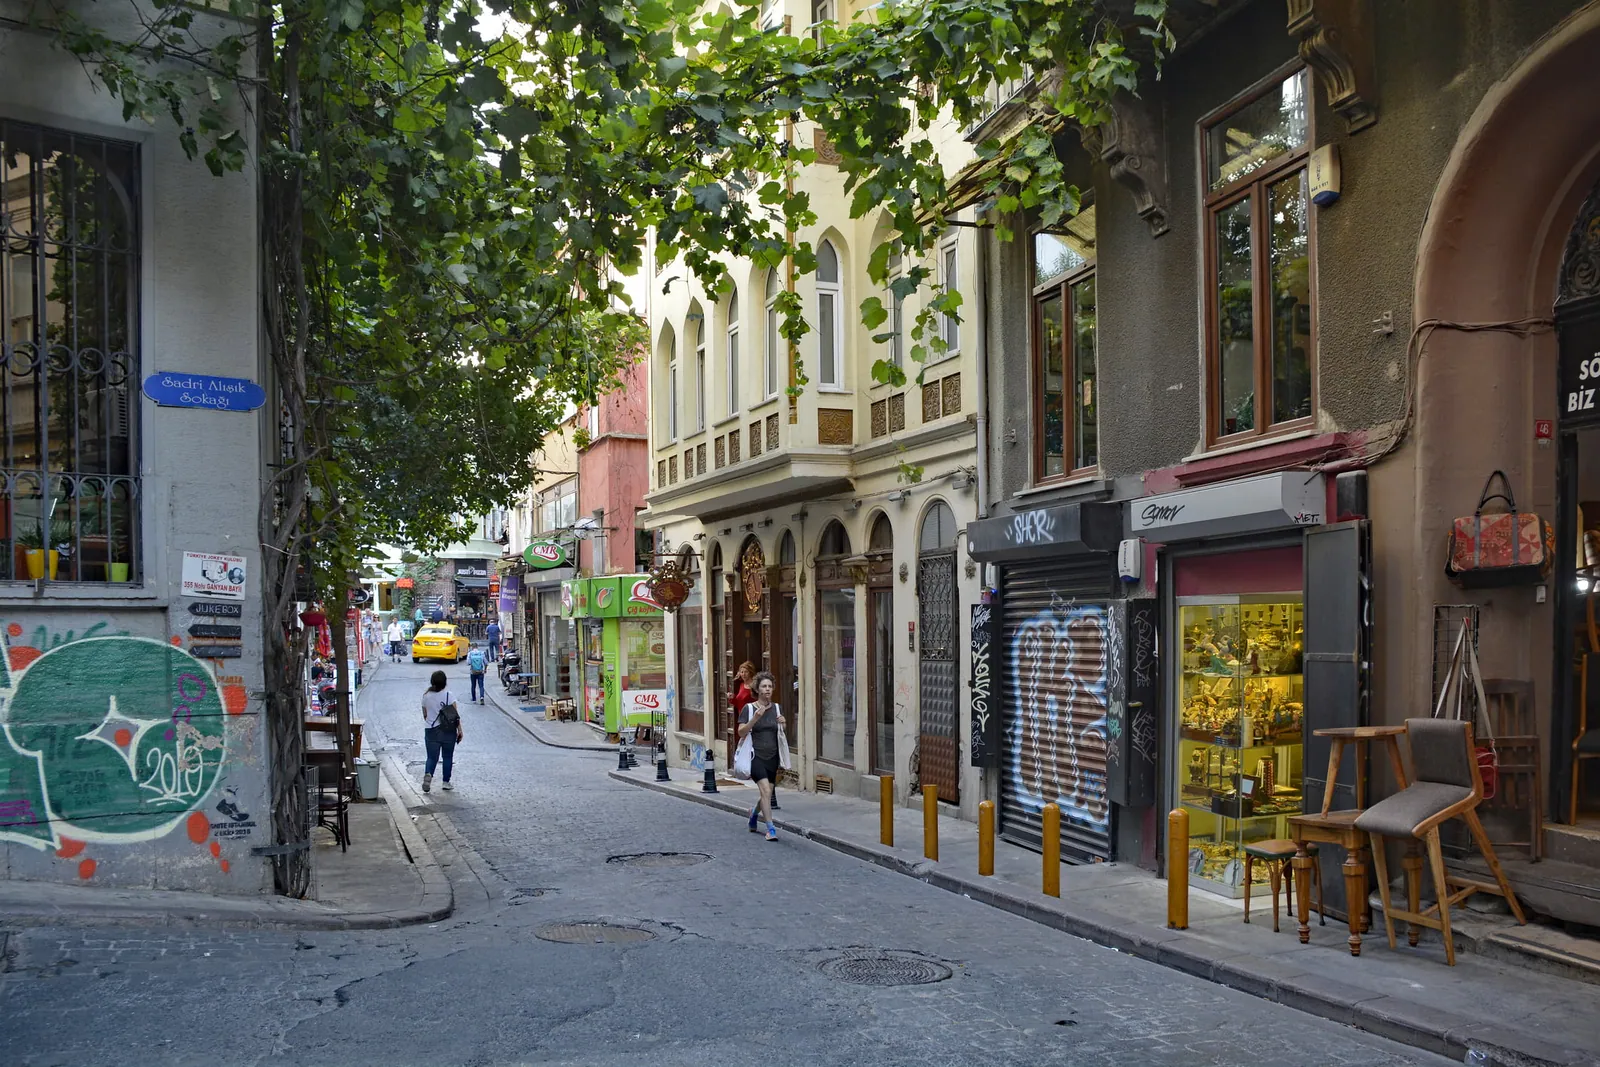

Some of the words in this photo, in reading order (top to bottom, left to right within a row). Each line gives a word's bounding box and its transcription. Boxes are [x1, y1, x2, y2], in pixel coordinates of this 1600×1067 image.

[161, 376, 203, 390] Sadri
[208, 380, 247, 394] Alışık
[179, 392, 230, 409] Sokağı
[1567, 385, 1596, 412] BİZ
[1539, 423, 1549, 435] 46
[533, 545, 559, 561] CMR
[206, 583, 228, 591] GANYAN
[195, 604, 239, 614] JUKEBOX
[634, 694, 660, 709] CMR
